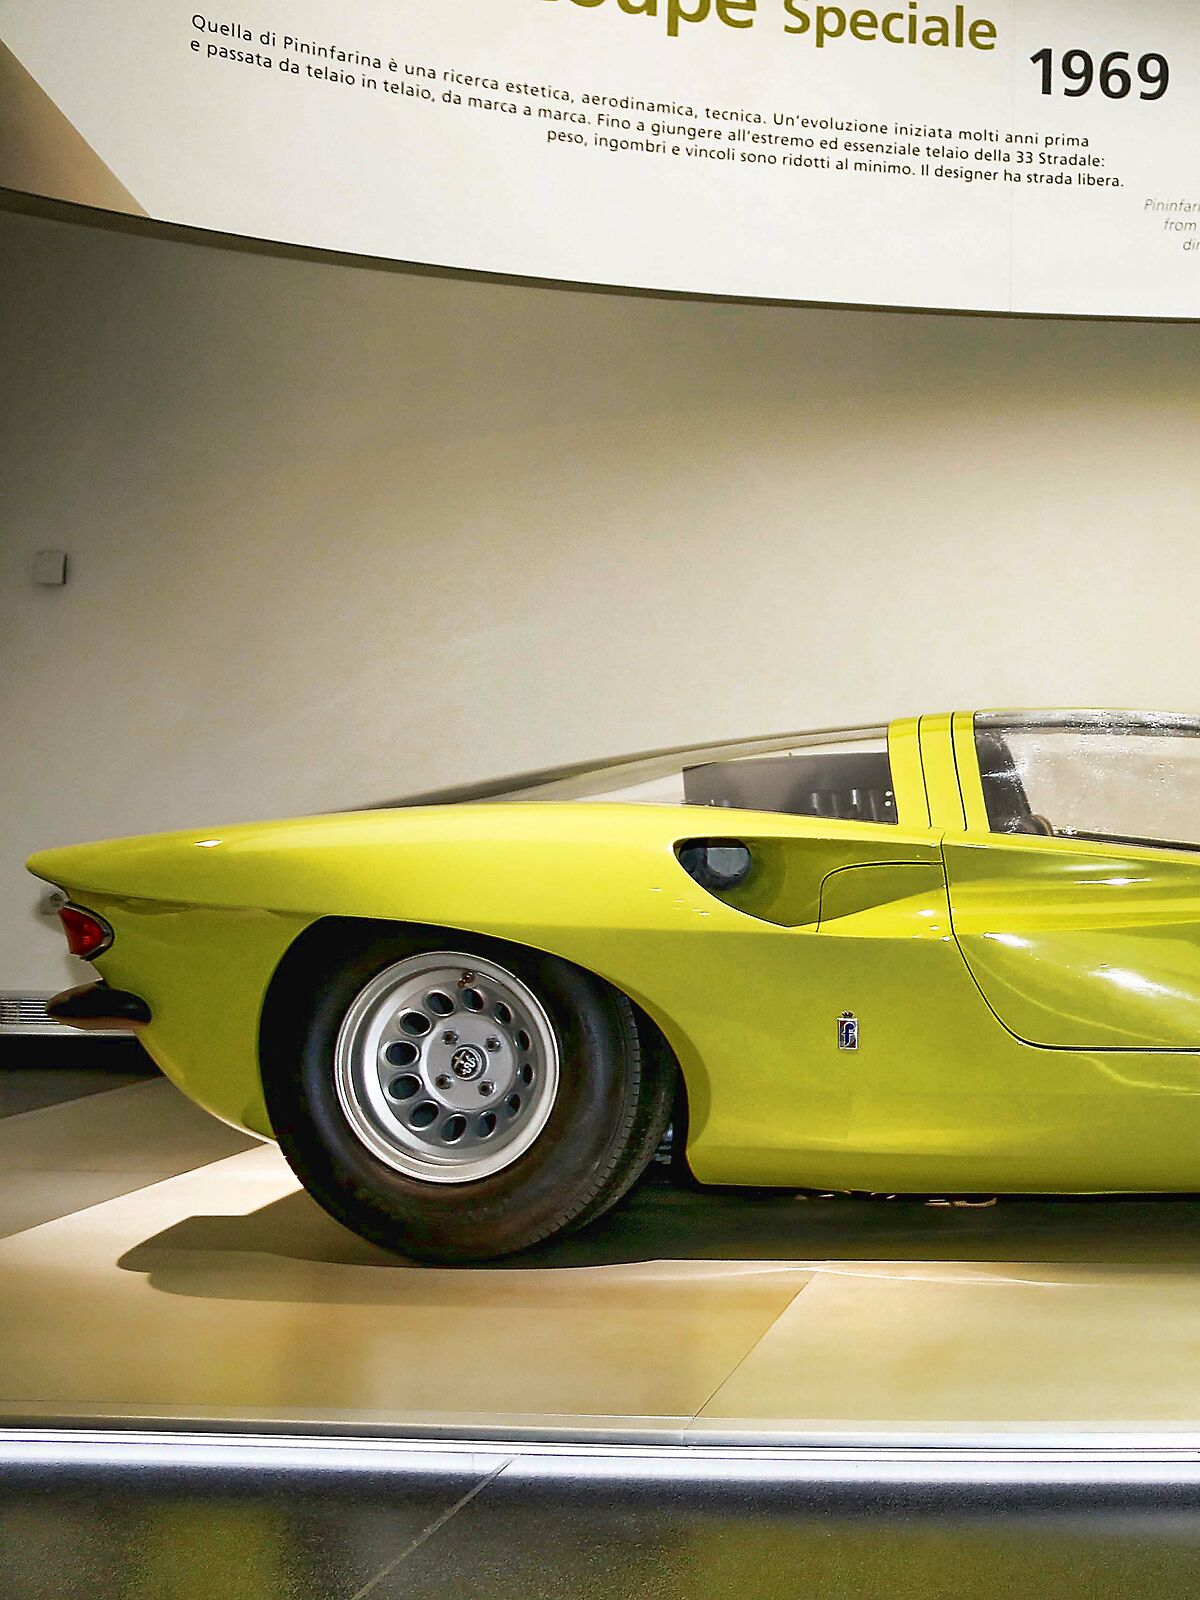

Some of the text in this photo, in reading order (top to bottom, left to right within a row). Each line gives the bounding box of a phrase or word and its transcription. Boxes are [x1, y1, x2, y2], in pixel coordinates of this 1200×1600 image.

[783, 0, 998, 50] Speciale
[191, 14, 253, 42] Quella
[259, 30, 277, 47] di
[283, 35, 382, 69] Pininfarina
[388, 57, 398, 73] è
[404, 64, 437, 80] una
[443, 68, 499, 91] ricerca
[505, 82, 575, 104] estetica,
[581, 93, 698, 118] aerodinamica,
[704, 107, 767, 125] tecnica.
[894, 122, 953, 140] iniziata
[958, 128, 999, 143] molti
[1004, 132, 1039, 145] anni
[1044, 133, 1089, 149] prima
[1029, 47, 1170, 100] 1969
[190, 39, 201, 52] e
[206, 43, 273, 69] passata
[278, 57, 300, 75] da
[305, 63, 356, 86] telaio
[361, 73, 377, 90] in
[382, 79, 436, 103] telaio,
[441, 89, 462, 105] da
[467, 96, 518, 115] marca
[522, 105, 532, 117] a
[537, 107, 592, 125] marca.
[597, 113, 632, 130] Fino
[636, 121, 645, 132] a
[650, 120, 723, 141] giungere
[819, 136, 839, 150] ed
[843, 141, 921, 157] essenziale
[925, 145, 970, 160] telaio
[973, 147, 1011, 163] della
[1015, 150, 1034, 164] 33
[1038, 151, 1105, 168] Stradale:
[546, 129, 1125, 188] peso, ingombri e vincoli sono ridotti al minimo. Il designer ha strada libera.
[1164, 217, 1197, 232] from
